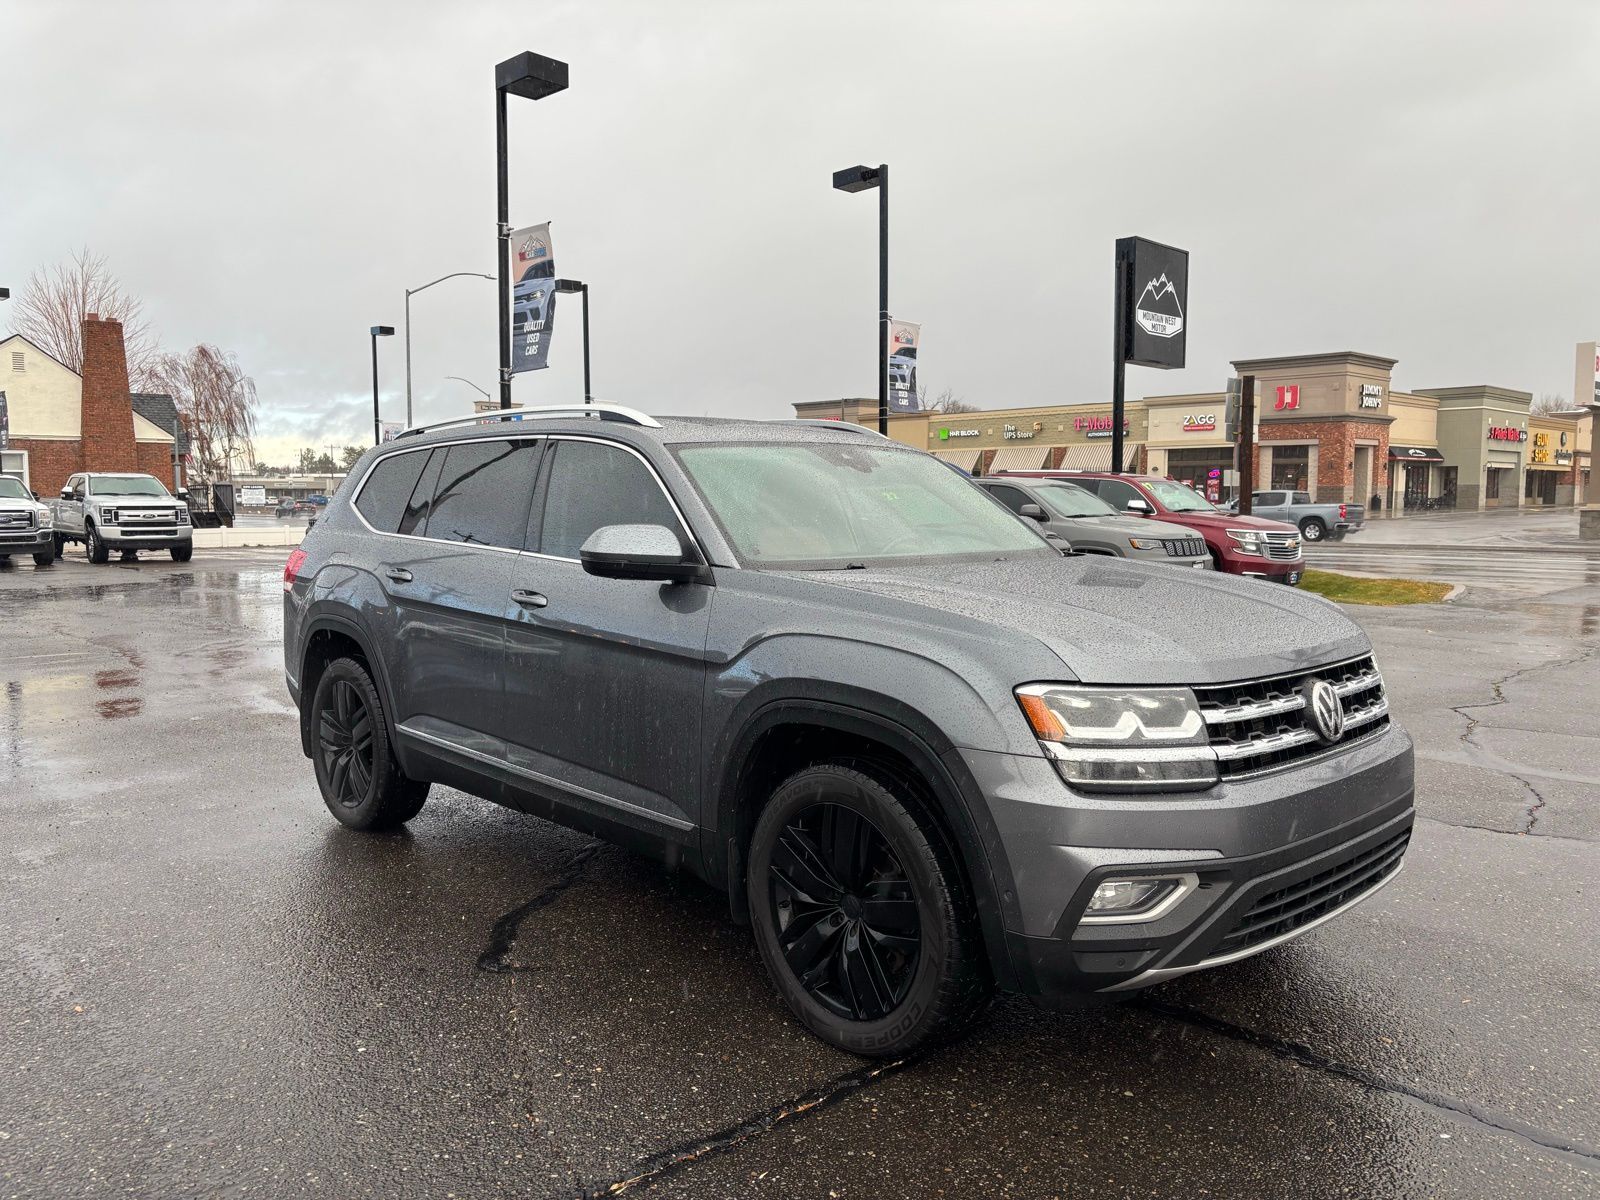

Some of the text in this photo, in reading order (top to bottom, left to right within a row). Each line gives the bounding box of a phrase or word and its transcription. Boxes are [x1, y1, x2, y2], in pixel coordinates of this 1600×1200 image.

[524, 320, 545, 332] QUALITY
[1164, 316, 1176, 326] WEST
[1152, 323, 1166, 333] MOTOR
[526, 332, 540, 344] USED
[525, 344, 539, 356] CARS
[1362, 384, 1382, 396] JIMMY
[898, 398, 909, 406] CARS
[1362, 397, 1382, 408] JOHN'S
[1074, 415, 1130, 431] T-Mobe
[1183, 414, 1216, 425] ZAGG
[960, 429, 980, 437] BLOCK
[1004, 424, 1016, 432] The
[1003, 430, 1034, 440] UPS Store
[1535, 432, 1550, 447] GUN
